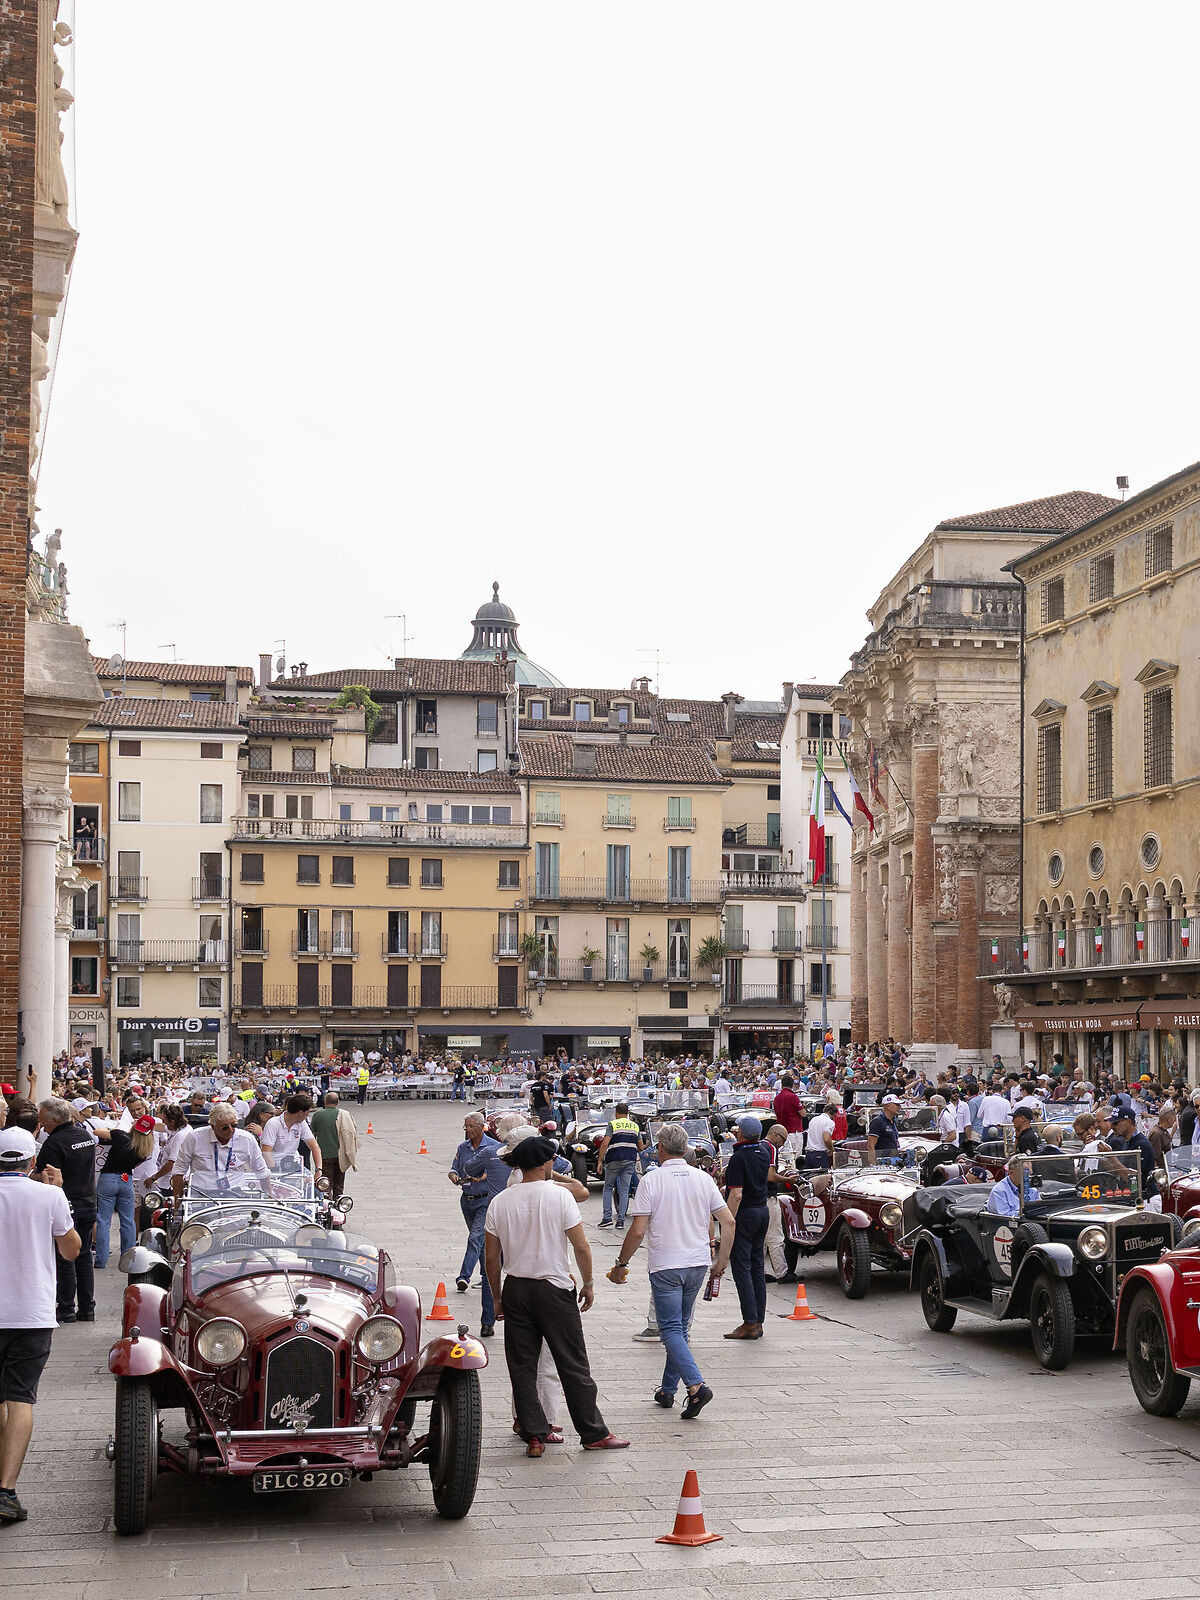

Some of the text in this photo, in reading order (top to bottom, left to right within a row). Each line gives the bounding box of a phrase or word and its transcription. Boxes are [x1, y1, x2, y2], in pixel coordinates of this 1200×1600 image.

[69, 1010, 105, 1020] DORIA
[122, 1020, 146, 1030] bar
[150, 1020, 184, 1030] venti
[1044, 1019, 1102, 1029] TESSUTI ALTA MODA
[1081, 1185, 1101, 1199] 45
[808, 1210, 820, 1222] 39
[1001, 1244, 1011, 1261] 45
[450, 1344, 481, 1359] 62
[270, 1394, 300, 1419] Alfa
[262, 1472, 344, 1490] FLC 820
